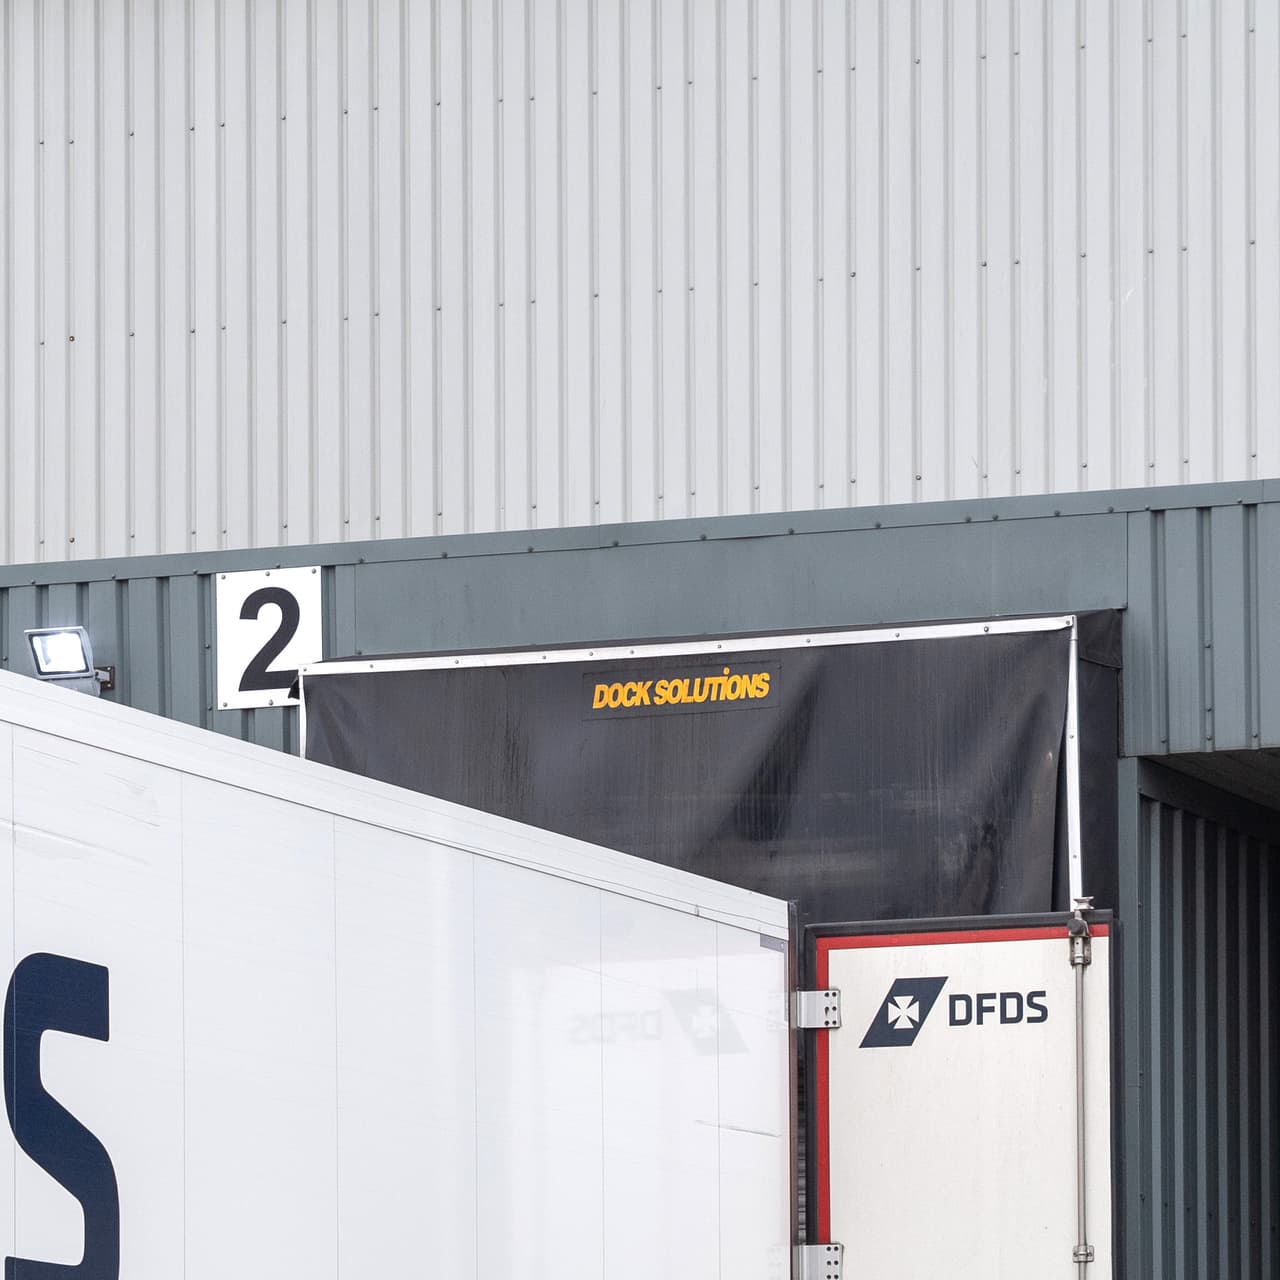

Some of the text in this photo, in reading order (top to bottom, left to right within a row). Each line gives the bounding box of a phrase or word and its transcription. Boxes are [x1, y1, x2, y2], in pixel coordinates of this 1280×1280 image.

[238, 586, 300, 692] 2
[592, 680, 653, 710] DOCK
[948, 990, 1049, 1027] DFDS
